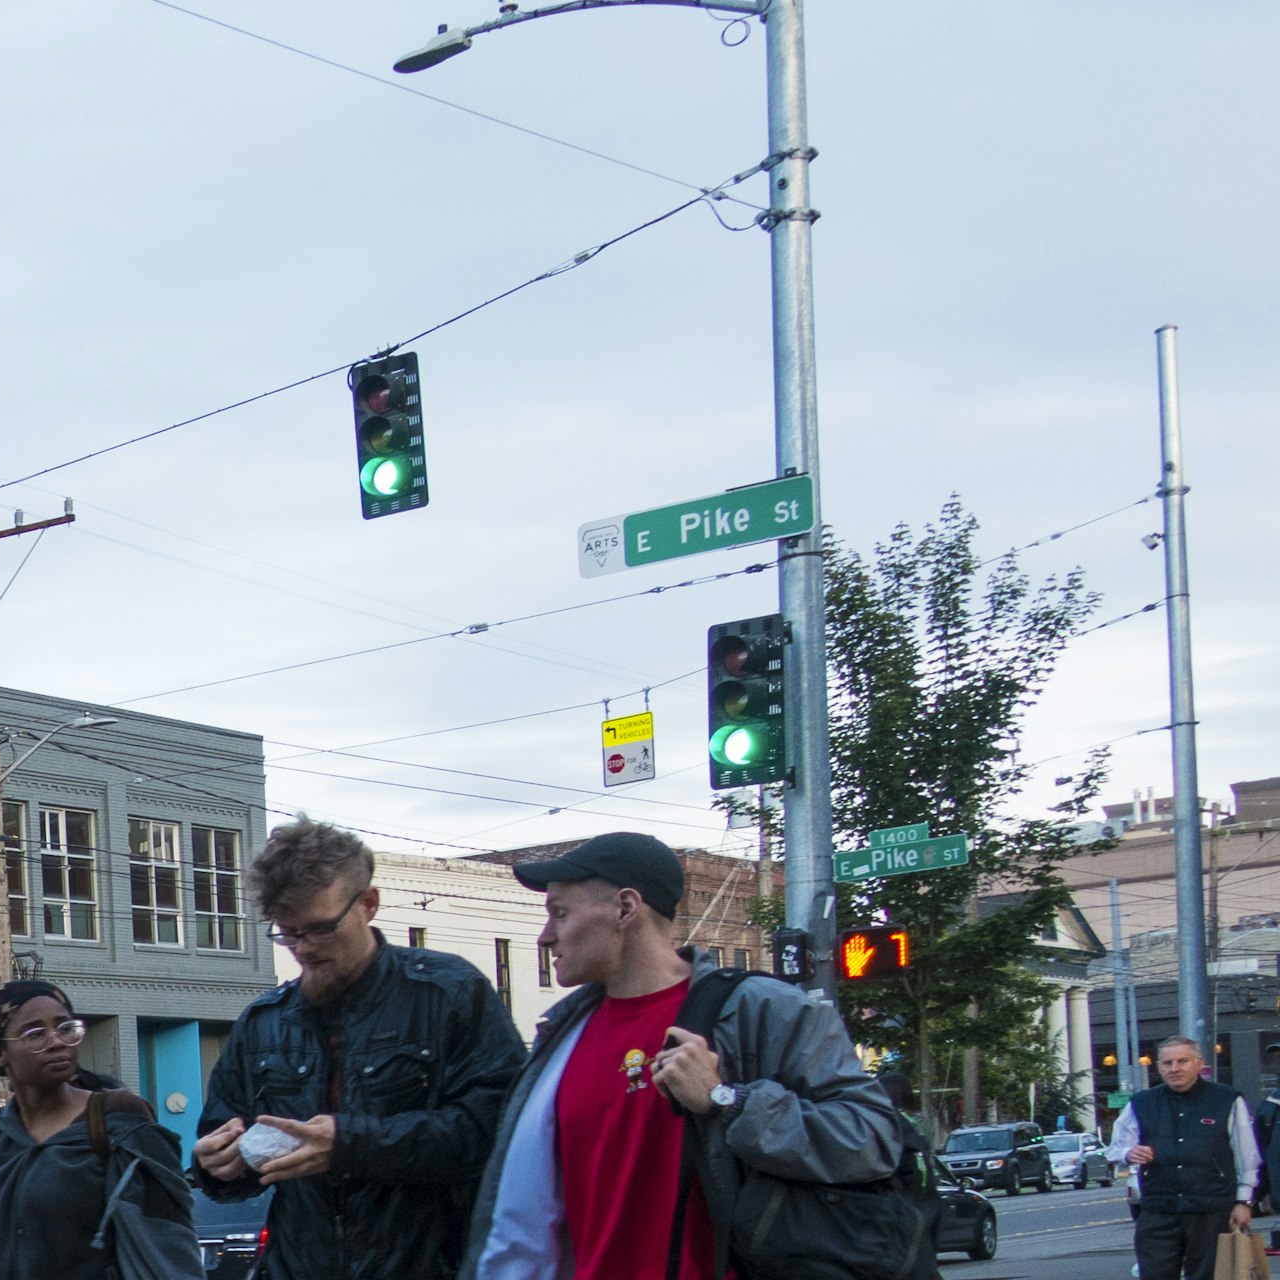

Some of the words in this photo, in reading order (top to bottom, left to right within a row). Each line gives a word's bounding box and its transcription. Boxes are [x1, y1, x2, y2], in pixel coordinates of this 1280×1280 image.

[636, 530, 652, 553] E
[680, 507, 751, 543] Pike
[774, 500, 800, 523] St
[584, 536, 619, 553] ARTS
[619, 718, 651, 730] TURNING
[619, 728, 651, 740] VEHICLES
[608, 758, 625, 769] STOP
[880, 829, 918, 845] 1400
[840, 861, 852, 876] E
[871, 848, 918, 871] Pike
[943, 848, 960, 861] ST
